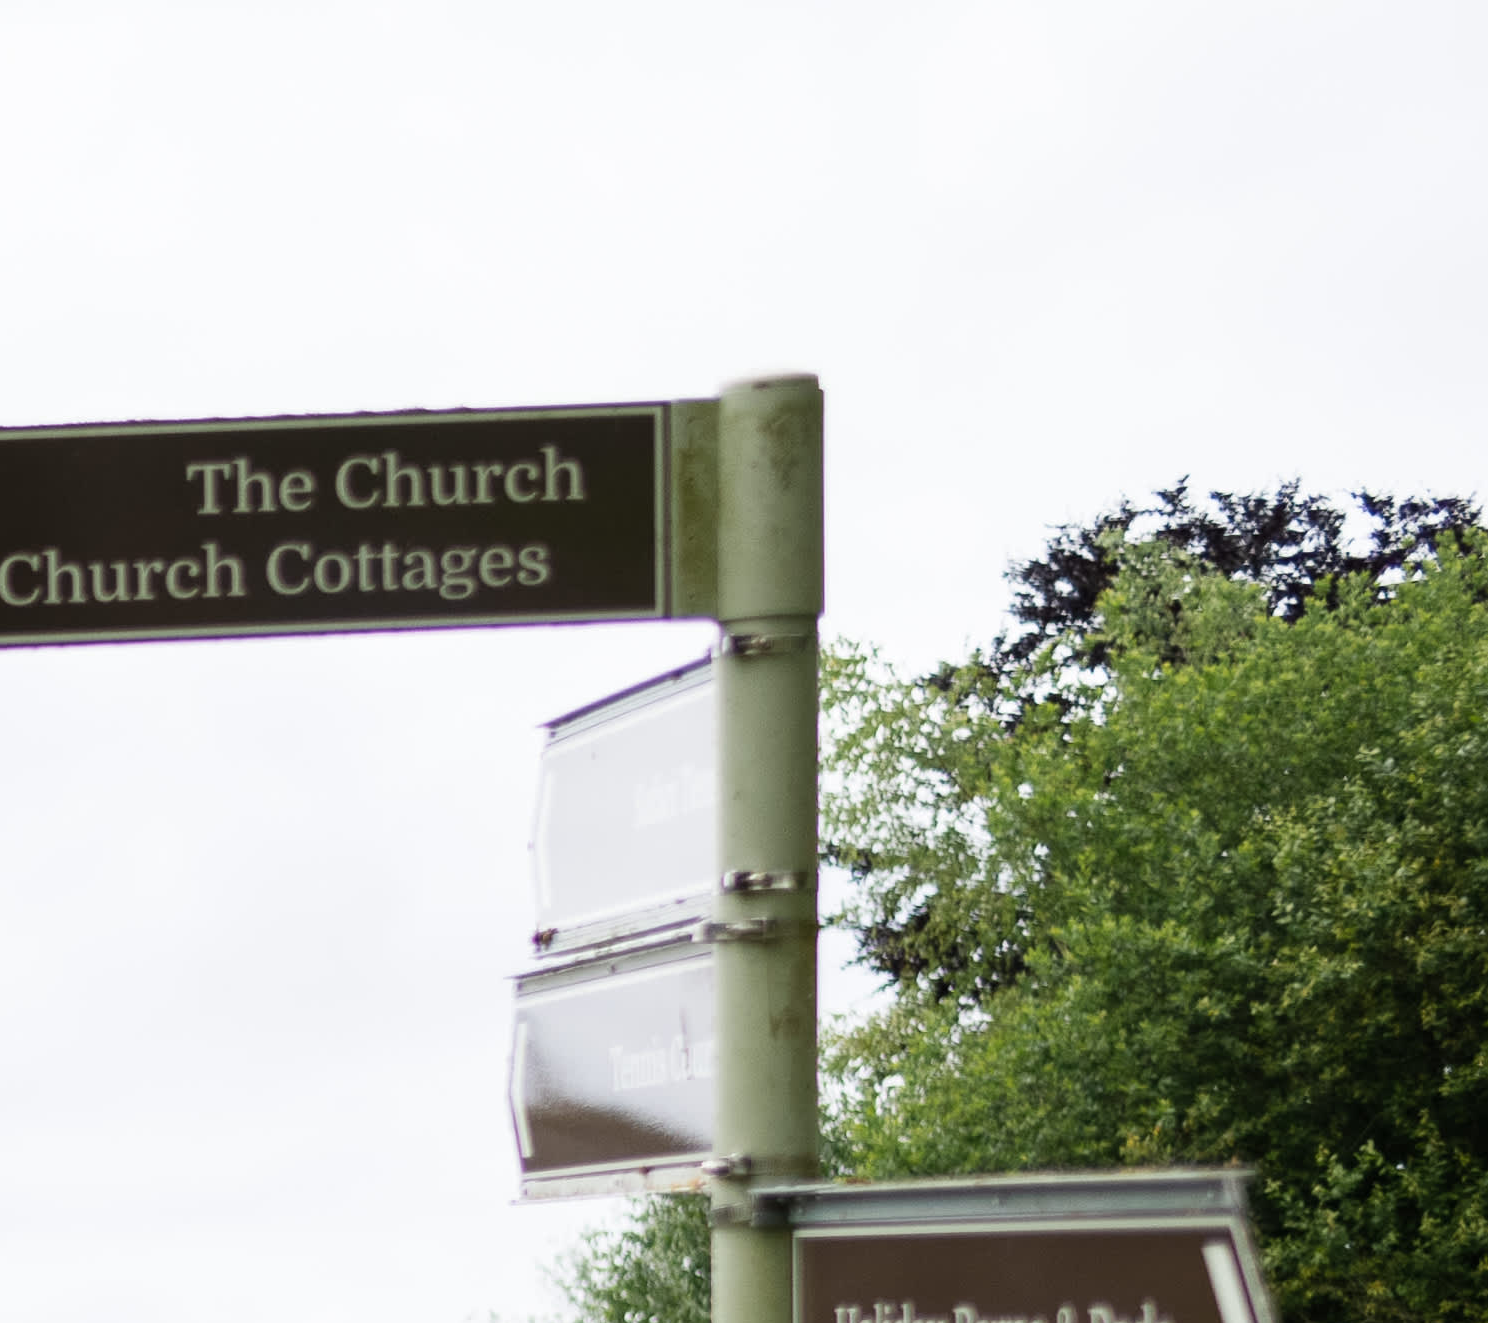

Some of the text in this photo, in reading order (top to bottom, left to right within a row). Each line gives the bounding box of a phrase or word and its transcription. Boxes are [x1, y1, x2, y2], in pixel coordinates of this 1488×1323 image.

[186, 445, 585, 515] The Church
[266, 542, 550, 599] Cottages
